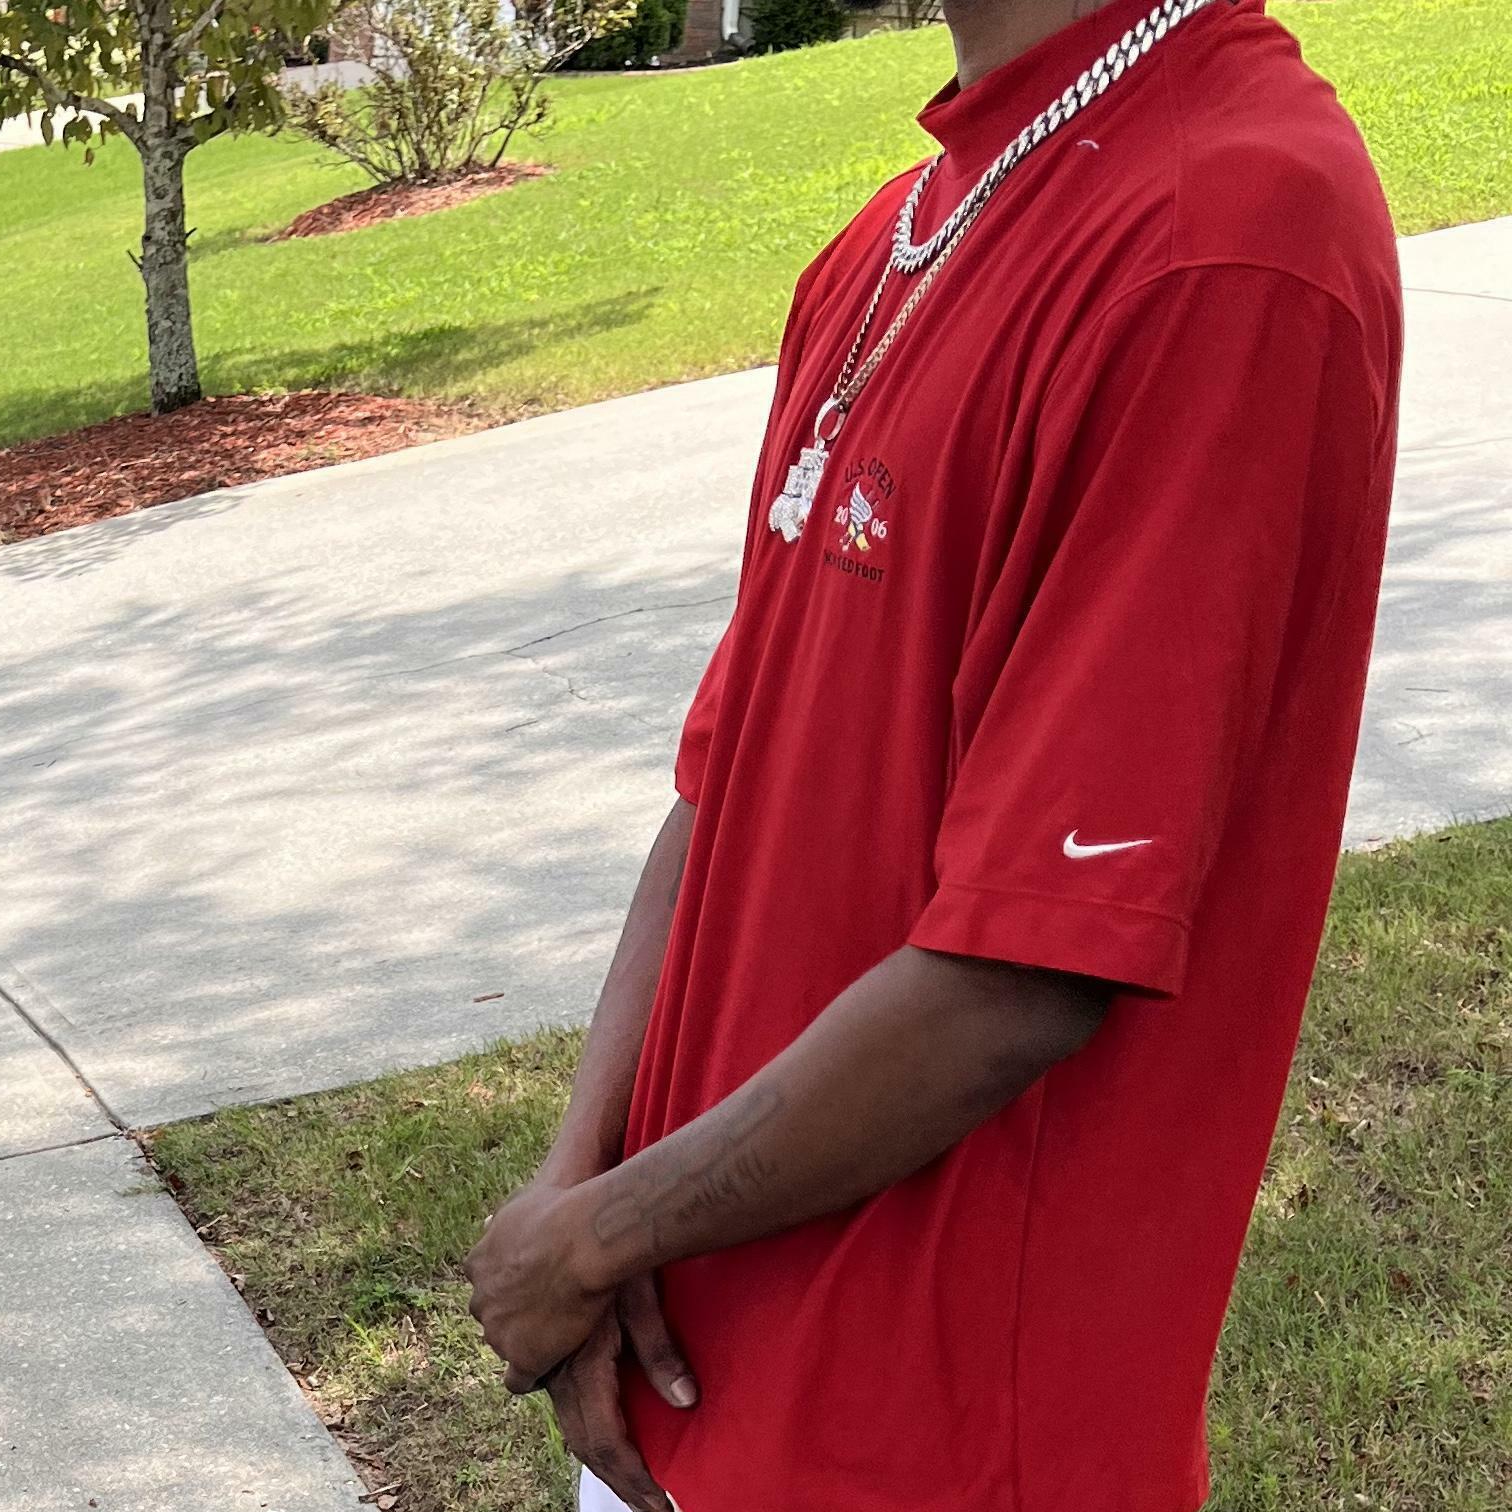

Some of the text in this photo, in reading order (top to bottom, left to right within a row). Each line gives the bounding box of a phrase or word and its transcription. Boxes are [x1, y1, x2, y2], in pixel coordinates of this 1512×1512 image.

[868, 457, 897, 499] OPEN
[834, 505, 888, 539] 20 06
[856, 562, 886, 582] FOOT
